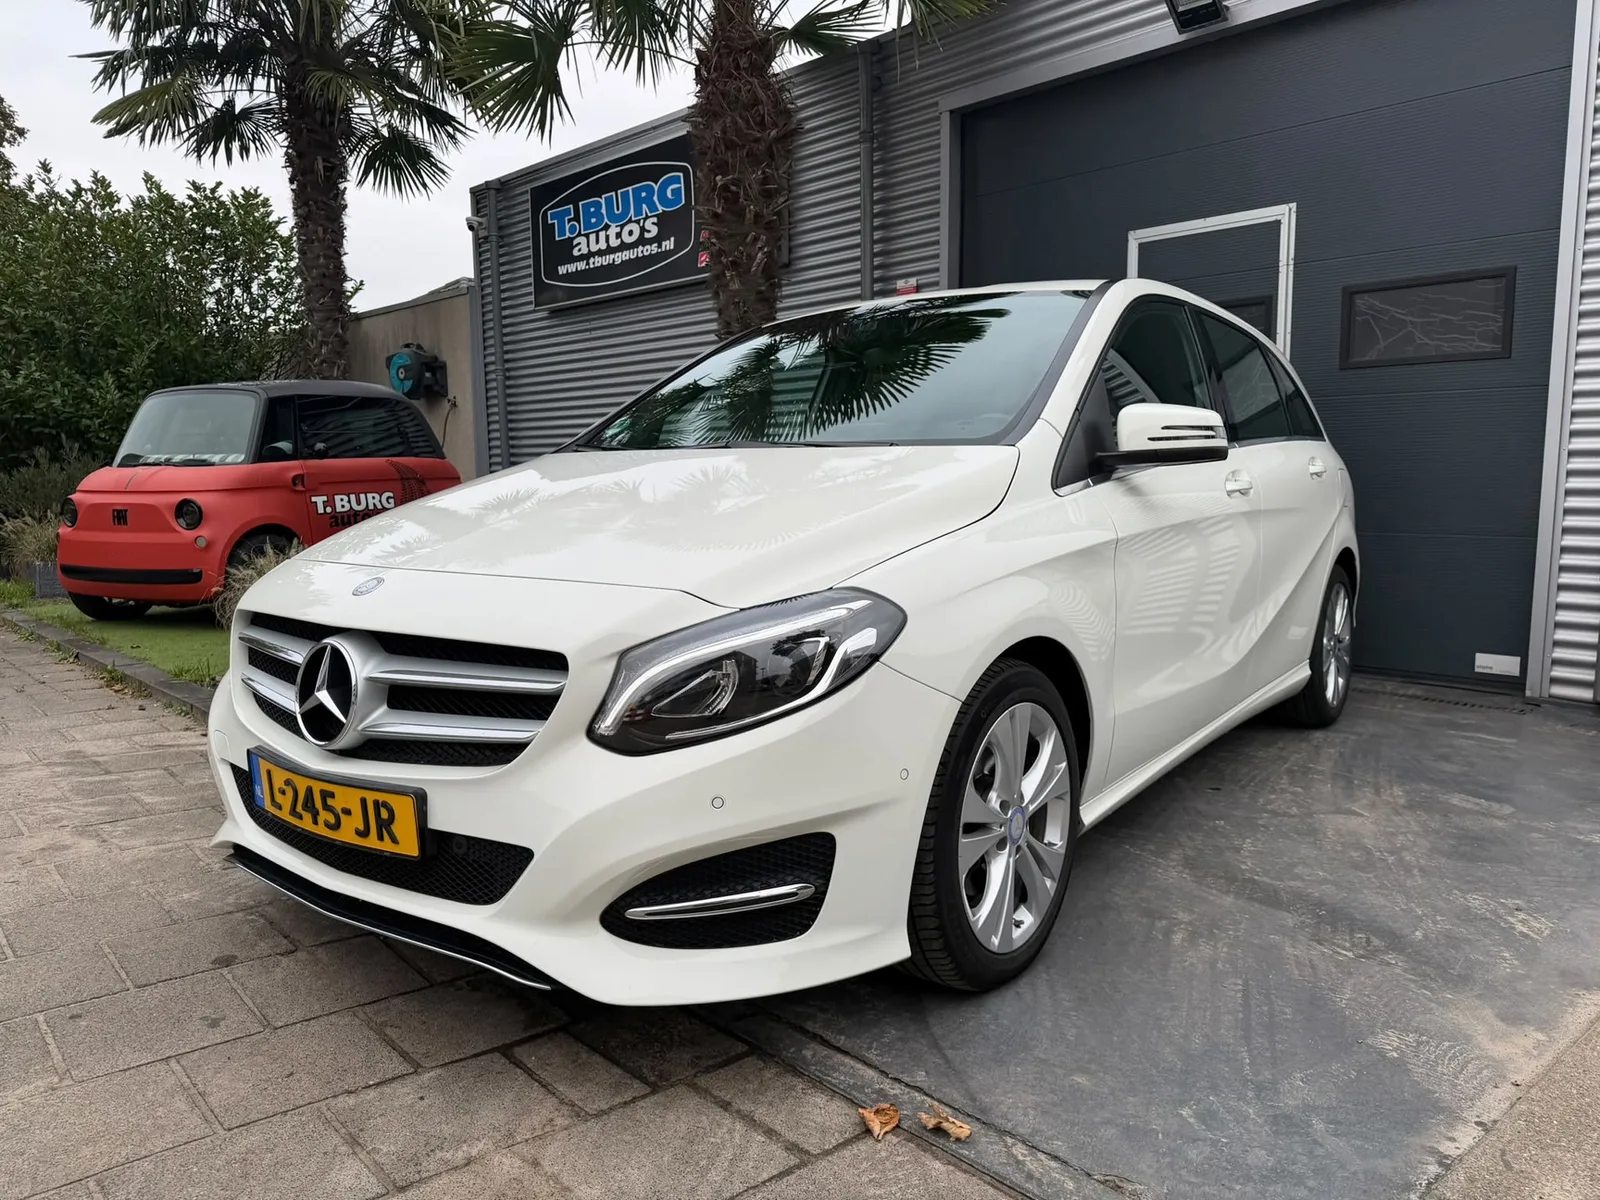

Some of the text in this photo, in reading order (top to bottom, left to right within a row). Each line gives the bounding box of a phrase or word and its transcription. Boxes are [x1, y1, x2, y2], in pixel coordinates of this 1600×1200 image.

[547, 172, 685, 240] T.BURG
[557, 237, 675, 275] www.tburgautos.nl
[572, 216, 659, 256] auto's
[111, 508, 129, 527] FIAT
[265, 768, 400, 845] L-245-JR
